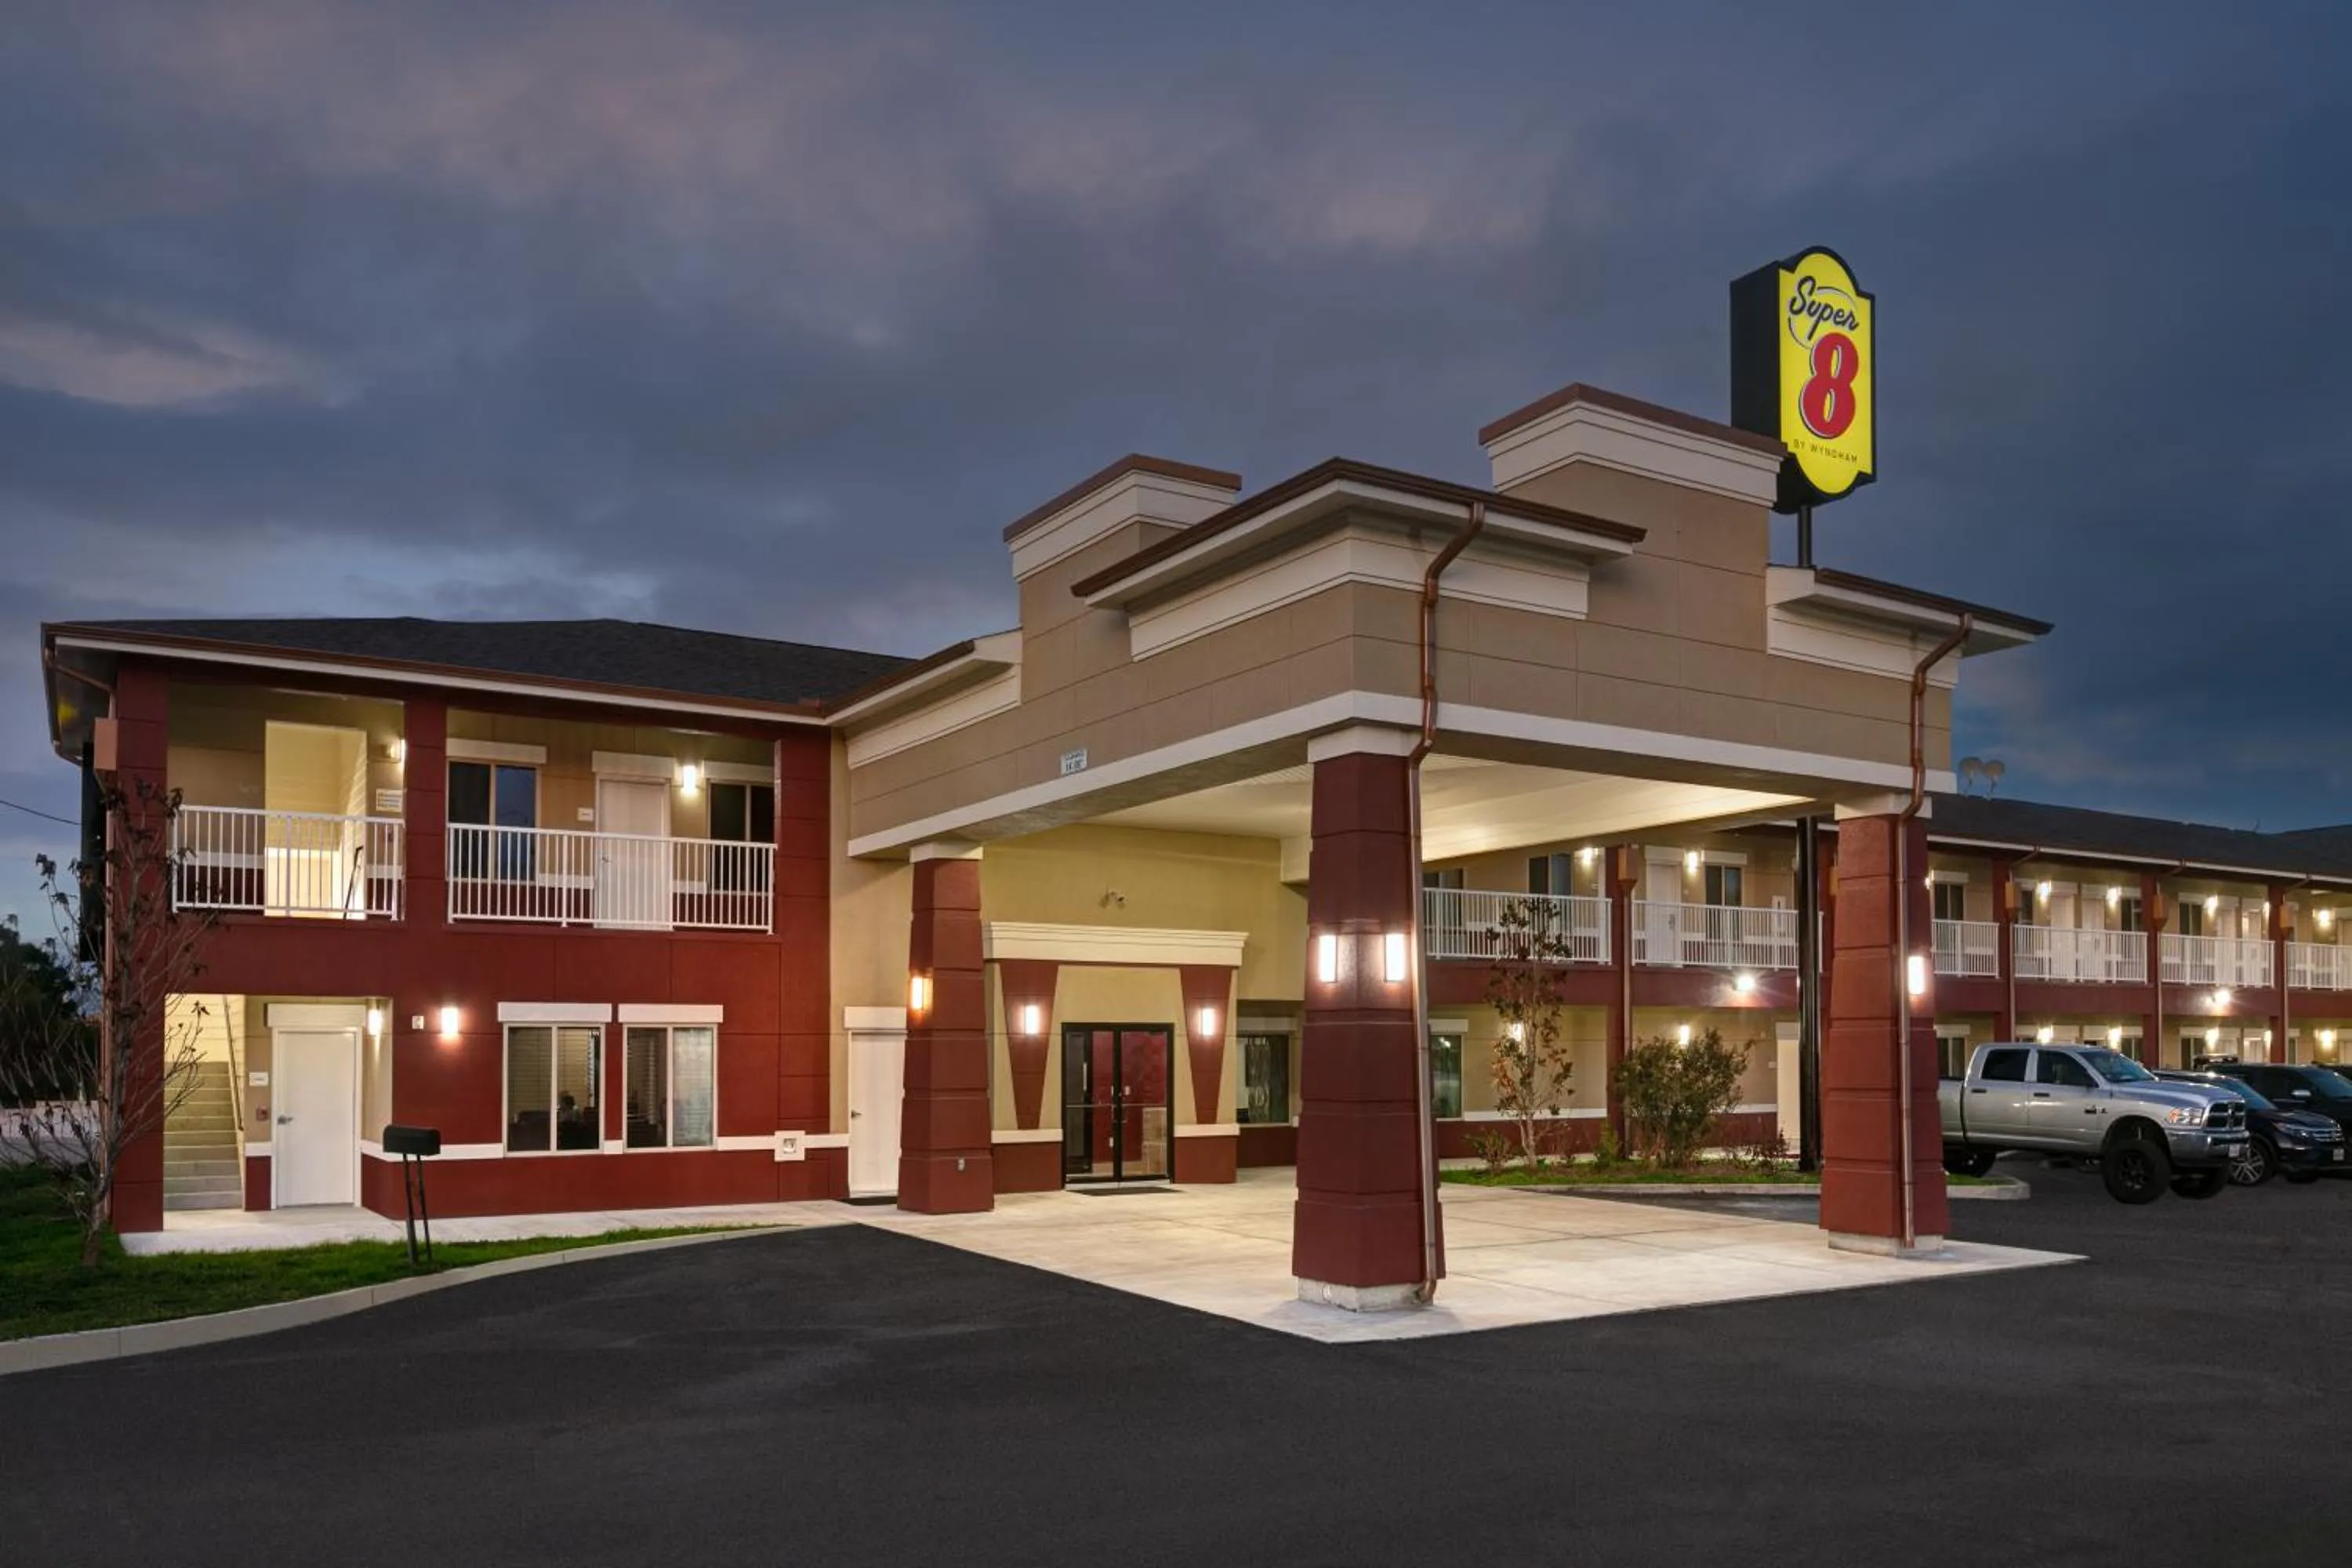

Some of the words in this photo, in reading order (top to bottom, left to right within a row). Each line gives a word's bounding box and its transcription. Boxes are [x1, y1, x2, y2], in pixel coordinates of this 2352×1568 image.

[1789, 276, 1859, 340] Super
[1799, 332, 1859, 440] 8
[1793, 438, 1806, 449] BY
[1810, 444, 1858, 463] WYNDHAM
